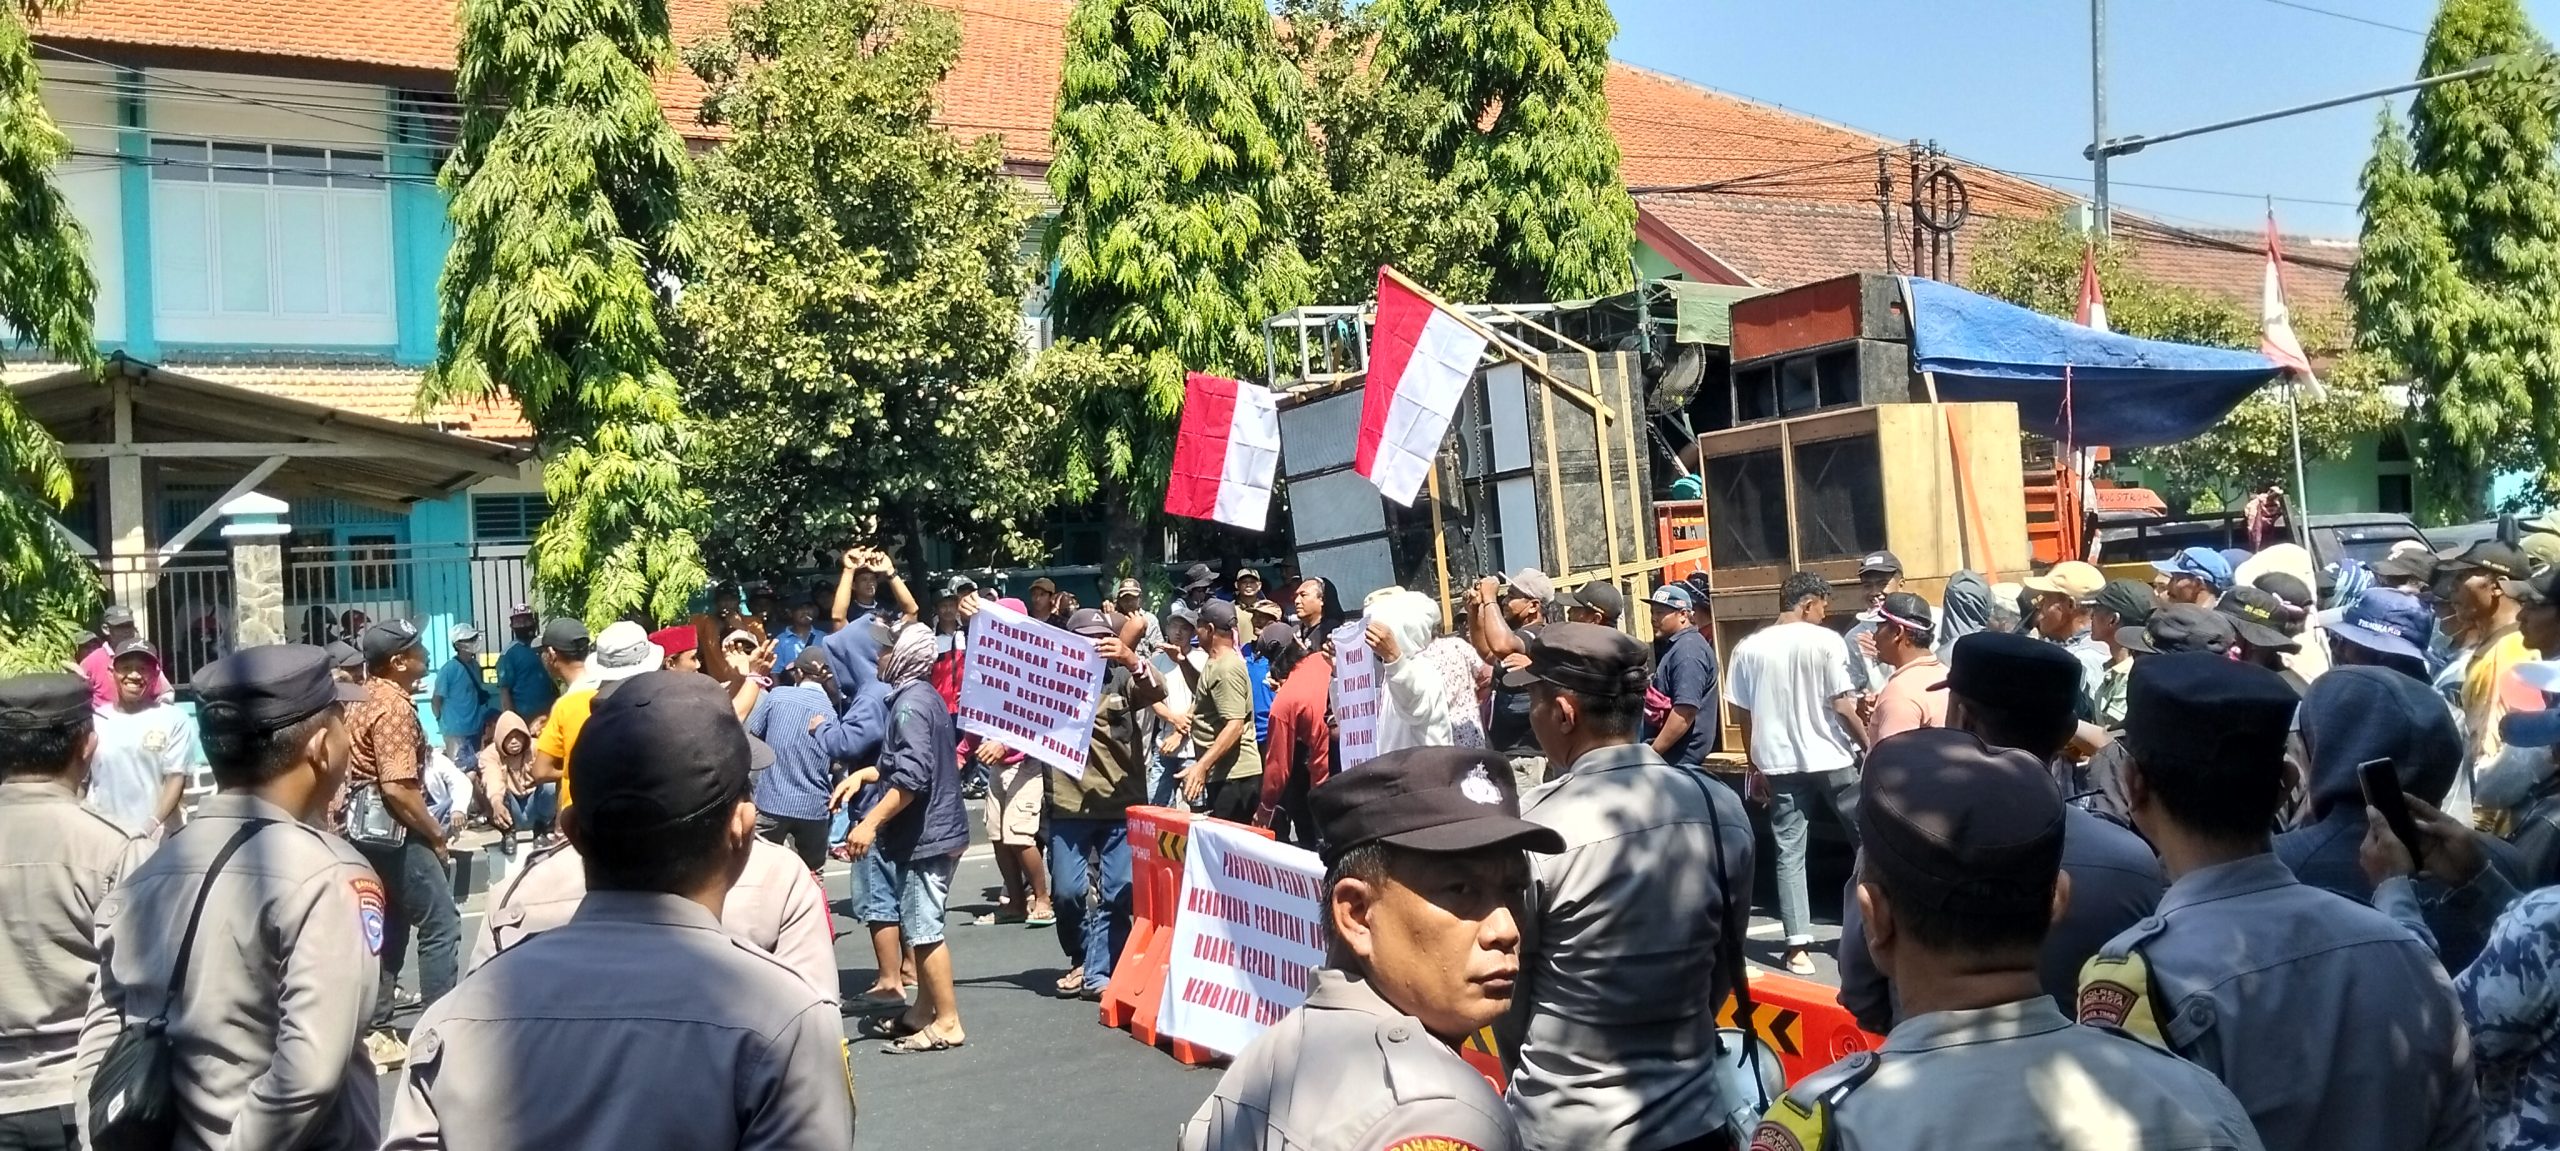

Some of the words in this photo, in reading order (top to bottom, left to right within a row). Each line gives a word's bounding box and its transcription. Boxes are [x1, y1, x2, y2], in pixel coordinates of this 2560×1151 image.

[979, 635, 1002, 652] APH
[1005, 644, 1048, 669] JANGAN
[1056, 662, 1093, 683] TAKUT
[991, 620, 1055, 651] PERHUTANI
[1062, 645, 1085, 662] DAN
[978, 654, 1021, 679] KEPADA
[1028, 673, 1088, 702] KELOMPOK
[981, 674, 1010, 692] YANG
[1016, 688, 1080, 720] BERTUJUAN
[961, 706, 1036, 742] KEUNTUNGAN
[1042, 738, 1085, 765] PRIBADI
[1003, 701, 1054, 729] MENCARI
[1274, 867, 1310, 900] PETANI
[1187, 886, 1250, 927] MENDUKUNG
[1254, 904, 1305, 945] PERHUTANI
[1193, 933, 1236, 967] RUANG
[1240, 944, 1276, 981] KEPADA
[1281, 958, 1309, 992] OKNU
